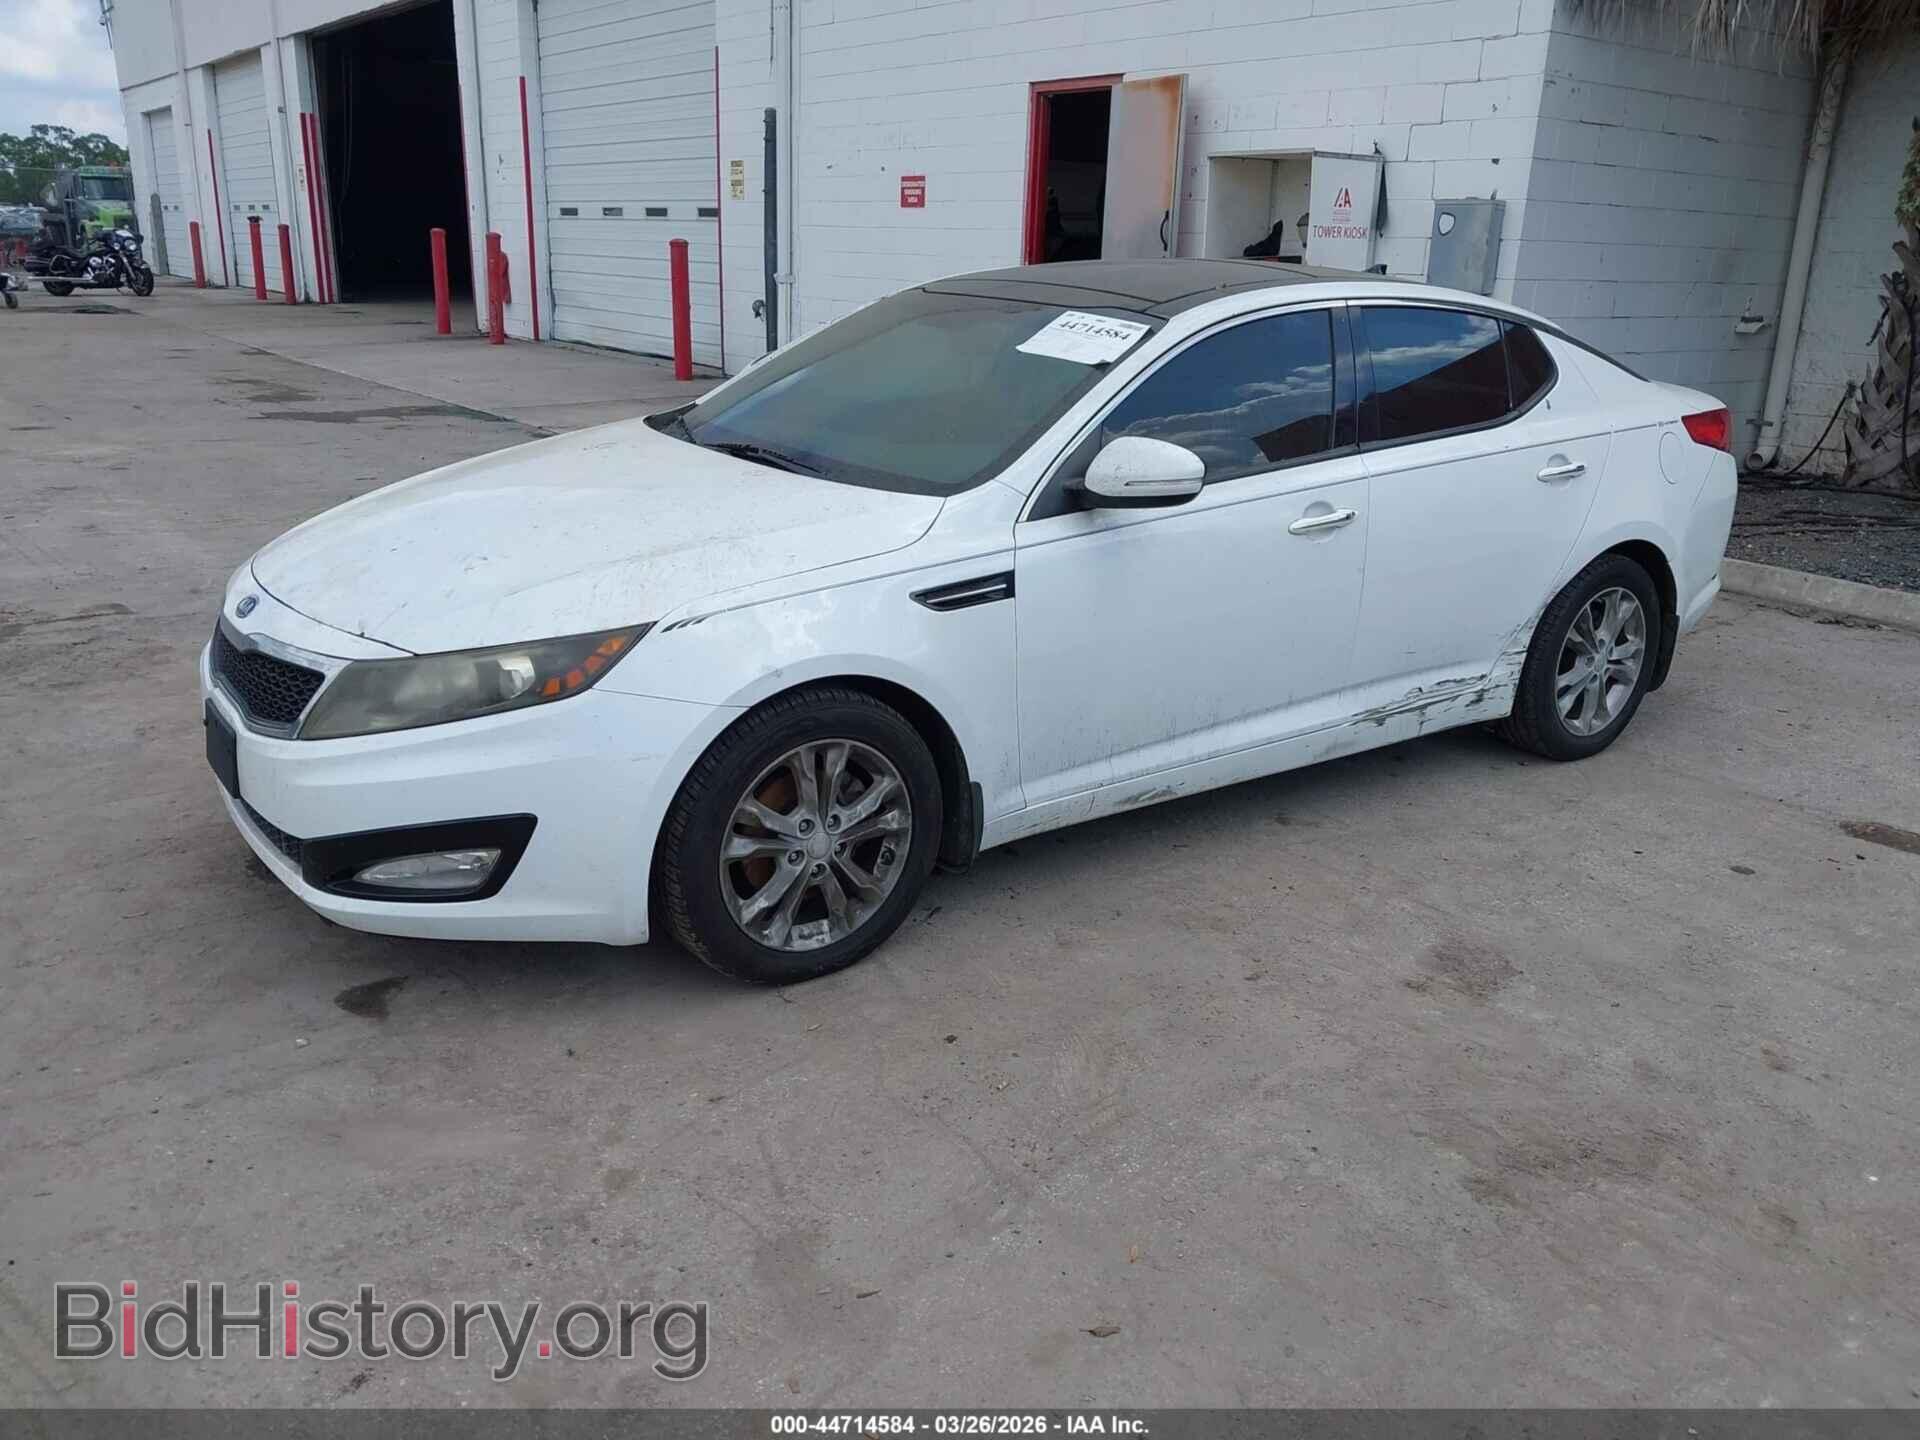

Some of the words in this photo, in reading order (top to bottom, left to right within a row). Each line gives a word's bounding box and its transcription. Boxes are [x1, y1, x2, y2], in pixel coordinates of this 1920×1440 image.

[1313, 225, 1342, 239] TOWER
[1344, 226, 1369, 240] KIOSK
[1058, 320, 1132, 341] 44714584
